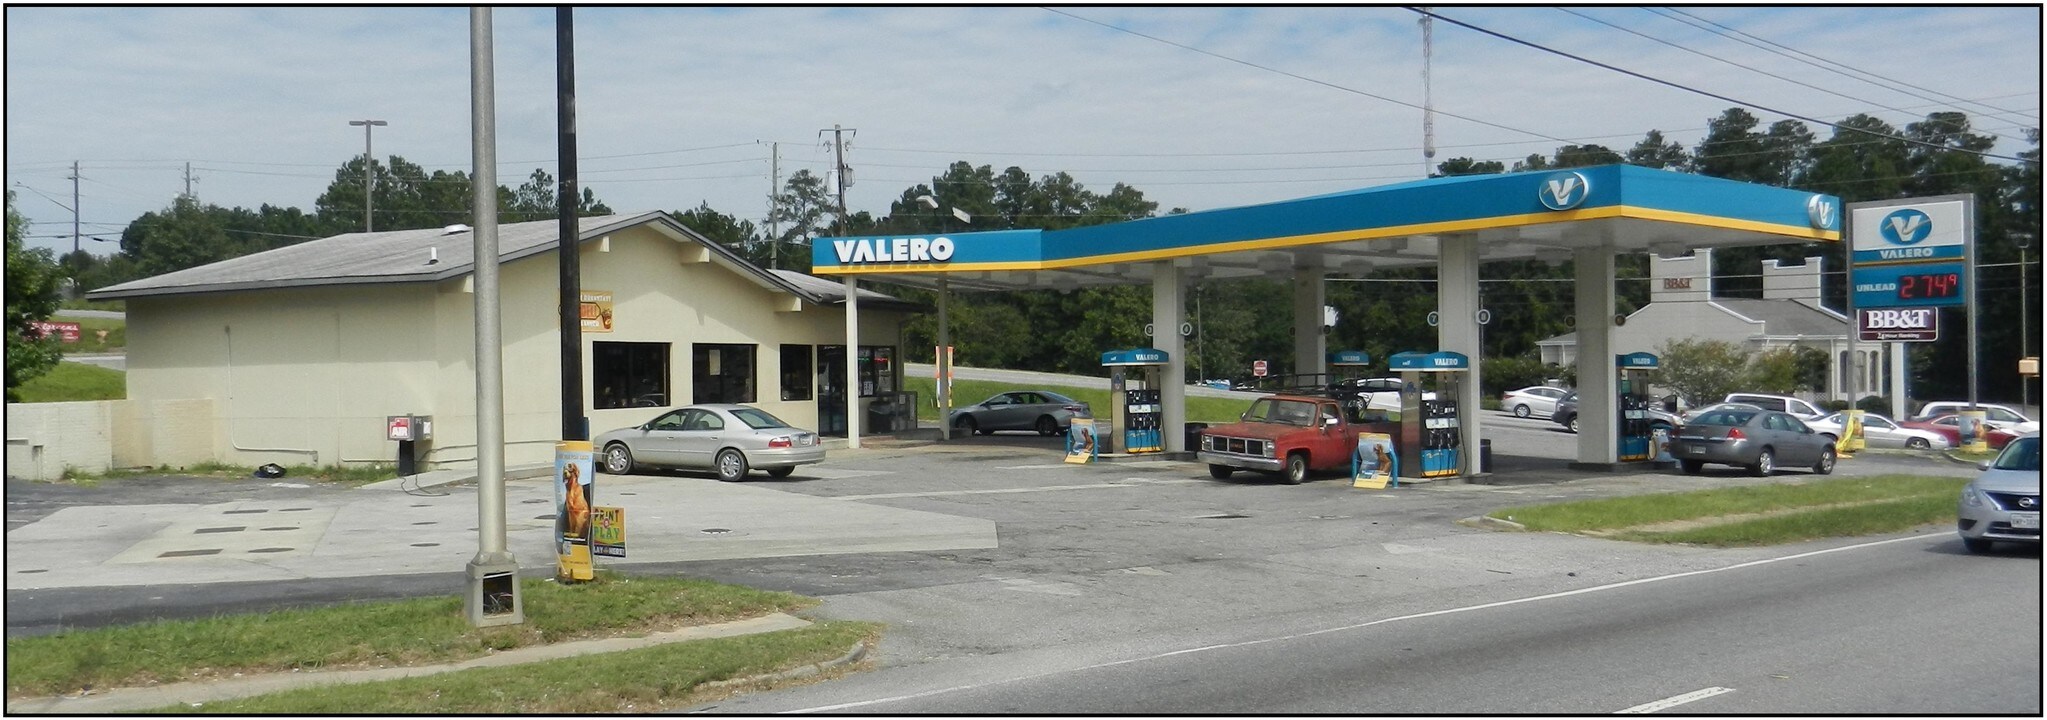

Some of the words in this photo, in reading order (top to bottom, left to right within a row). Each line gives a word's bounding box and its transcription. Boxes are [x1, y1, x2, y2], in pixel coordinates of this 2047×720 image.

[833, 237, 955, 263] VALERO
[1879, 247, 1934, 260] VALERO
[1856, 283, 1897, 293] UNLEAD
[1866, 309, 1931, 329] BB&T
[1135, 353, 1159, 361] VALERO
[1433, 358, 1459, 366] VALERO
[593, 508, 620, 523] PRINT
